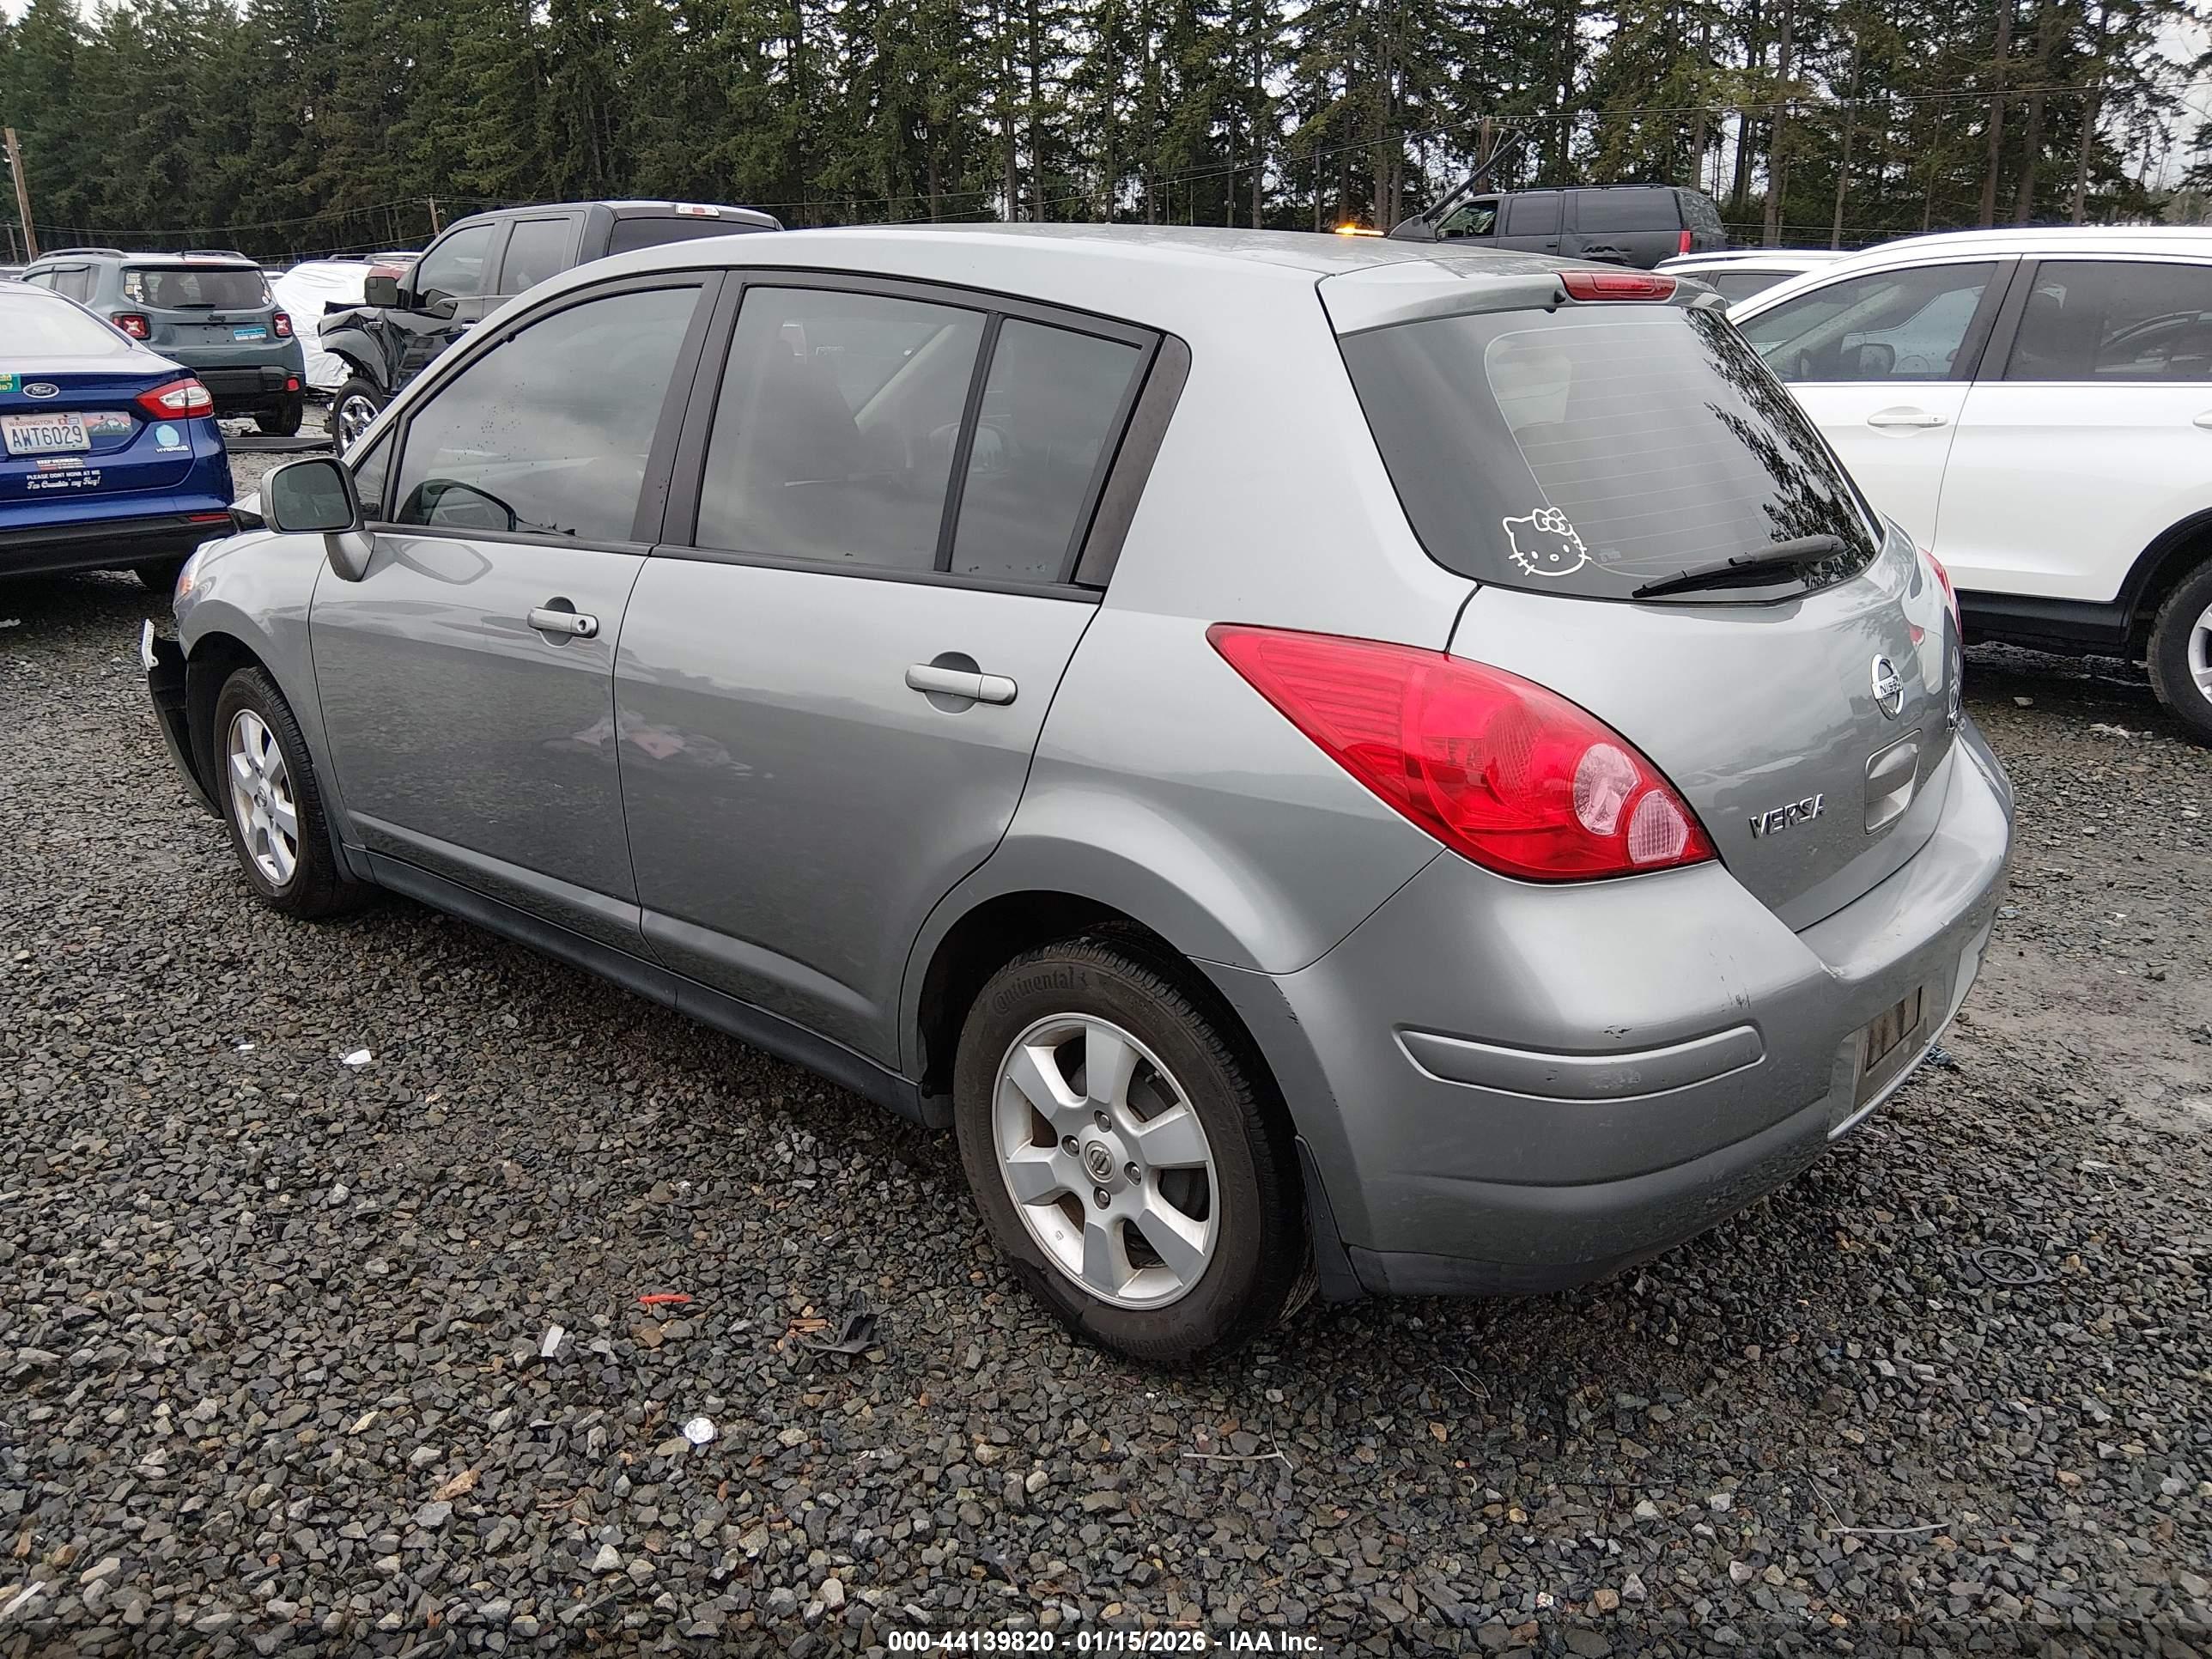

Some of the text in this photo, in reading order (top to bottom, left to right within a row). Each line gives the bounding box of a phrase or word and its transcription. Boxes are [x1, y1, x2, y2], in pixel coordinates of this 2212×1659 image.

[12, 426, 83, 447] AWT6029
[1749, 793, 1826, 839] VERSA
[993, 966, 1075, 1016] Continental
